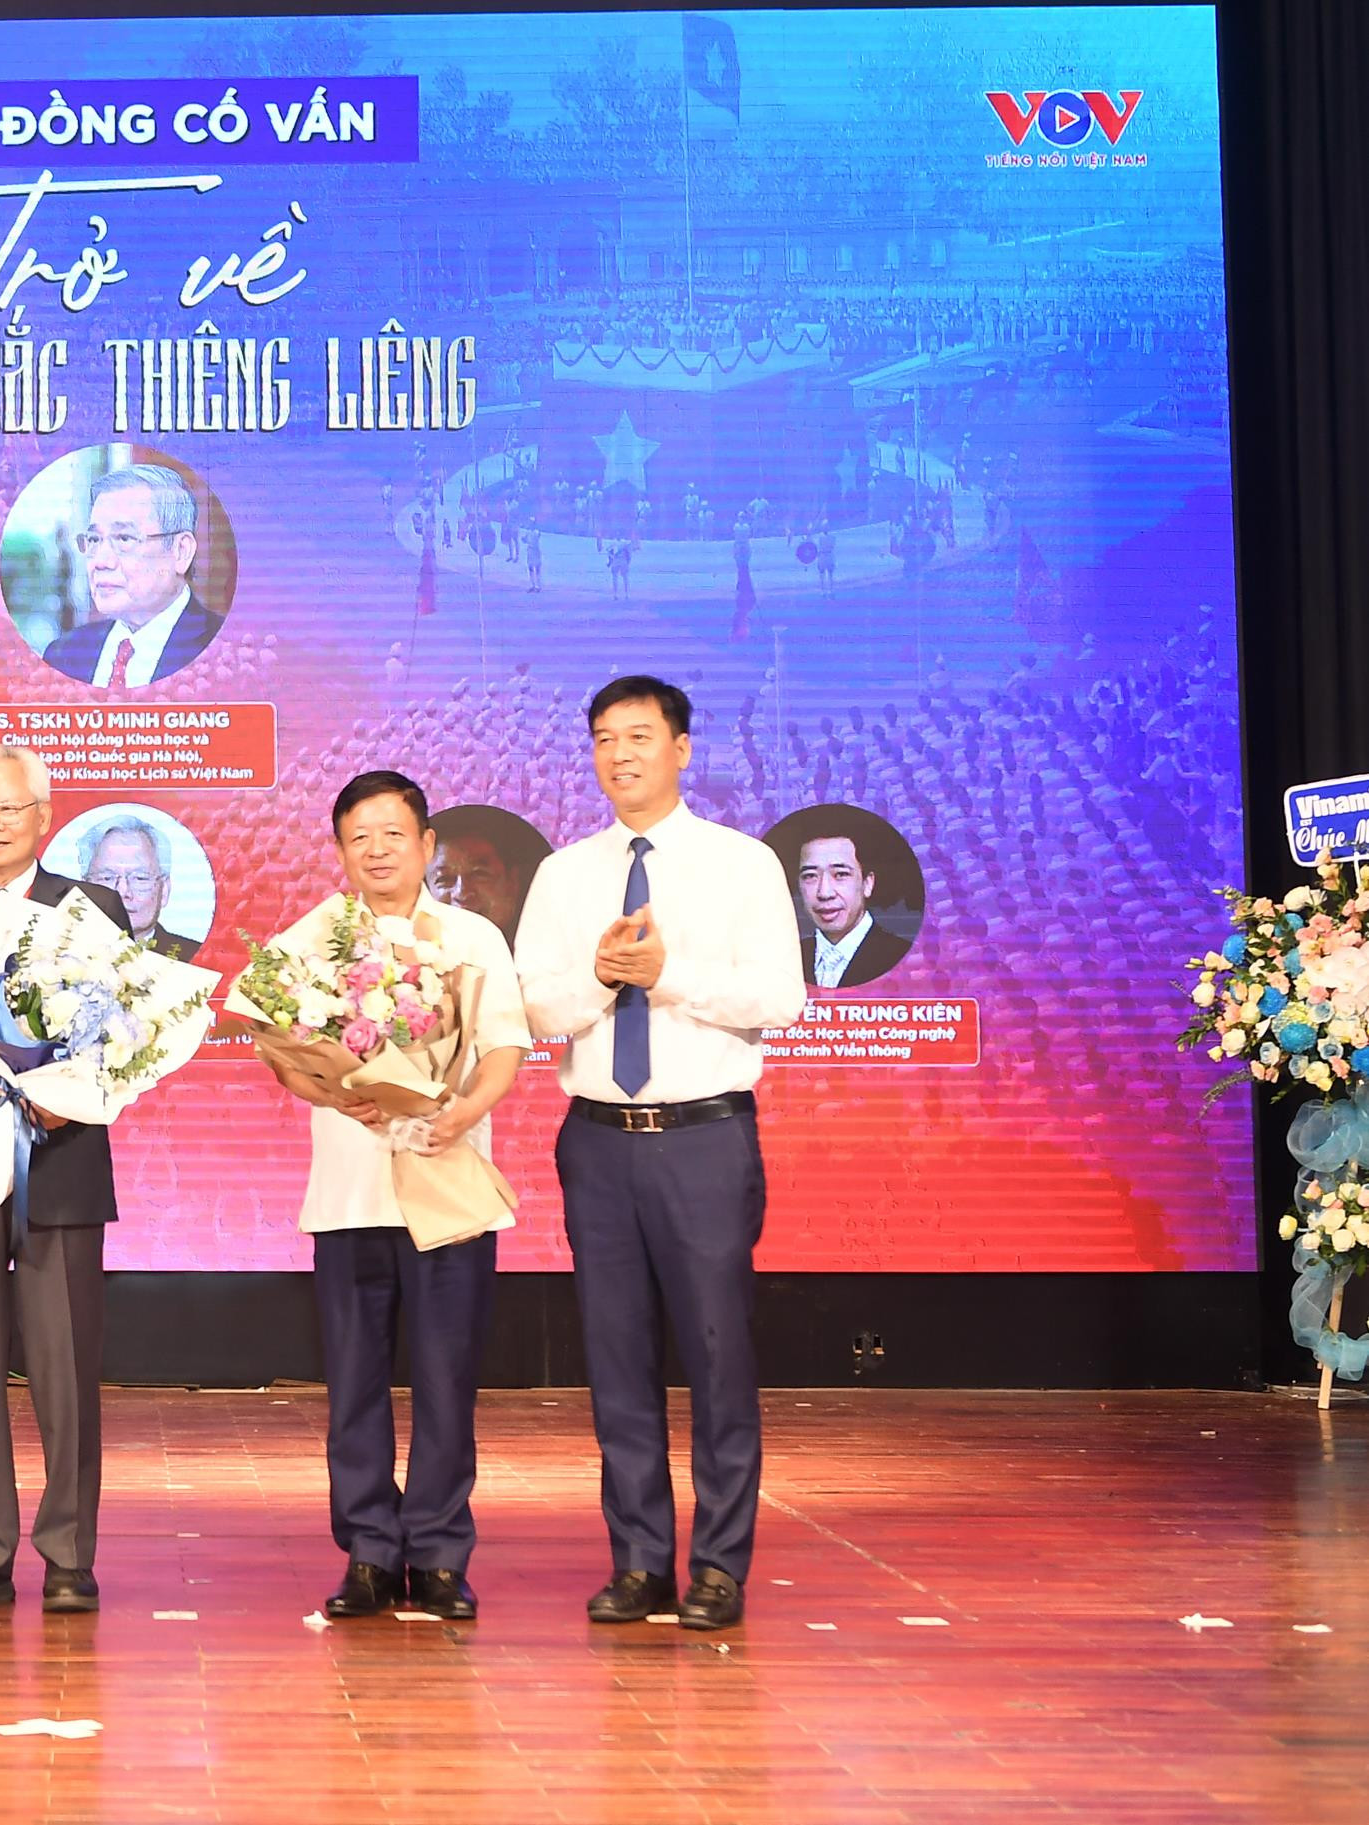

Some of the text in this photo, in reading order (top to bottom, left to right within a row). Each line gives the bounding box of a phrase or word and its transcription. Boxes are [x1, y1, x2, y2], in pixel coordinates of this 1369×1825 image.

[172, 88, 249, 142] CỐ
[268, 86, 375, 142] VẤN
[984, 89, 1143, 148] VOV
[985, 151, 1147, 169] TIẾNG NÓI VIỆT NAM
[179, 201, 308, 306] về
[101, 322, 291, 433] THIÊNG
[326, 318, 477, 432] LIÊNG
[18, 713, 71, 730] TSKH
[75, 709, 103, 728] VŨ
[107, 712, 160, 728] MINH
[163, 711, 230, 728] GIANG
[32, 735, 58, 748] tịch
[61, 734, 85, 748] Hội
[126, 733, 161, 746] Khoa
[164, 732, 190, 748] học
[192, 734, 210, 745] và
[64, 750, 86, 763] ĐH
[88, 748, 126, 763] Quốc
[129, 750, 150, 764] gia
[153, 750, 172, 762] Hà
[48, 767, 71, 782] Hội
[73, 767, 109, 780] Khoa
[111, 767, 137, 782] học
[139, 767, 169, 782] Lịch
[190, 767, 218, 782] Việt
[220, 767, 253, 780] Nam
[1295, 792, 1369, 819] Vinam
[835, 1004, 908, 1023] TRUNG
[912, 1001, 962, 1022] KIÊN
[785, 1025, 813, 1040] đốc
[815, 1027, 844, 1042] Học
[846, 1027, 877, 1042] viện
[878, 1026, 917, 1042] Công
[919, 1026, 957, 1042] nghệ
[524, 1051, 552, 1062] am
[792, 1043, 832, 1056] chính
[833, 1041, 867, 1057] Viễn
[868, 1043, 911, 1059] thông
